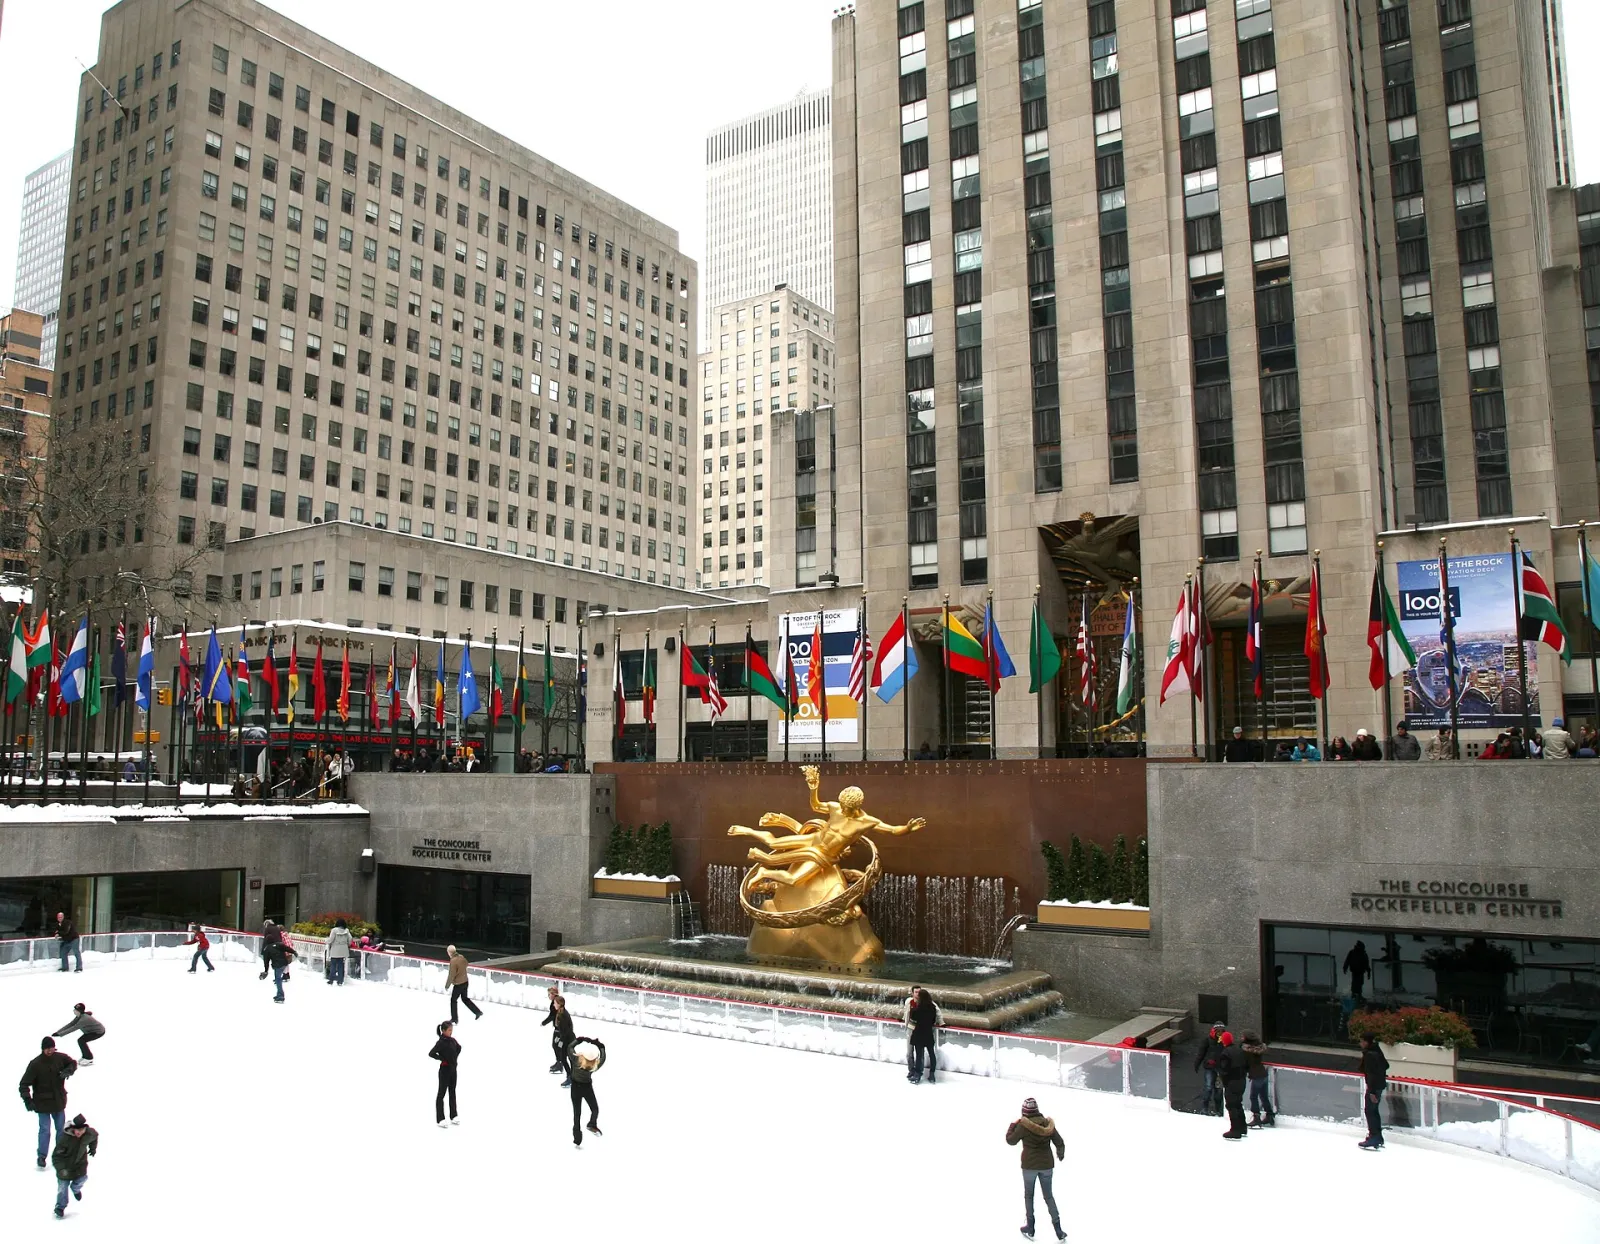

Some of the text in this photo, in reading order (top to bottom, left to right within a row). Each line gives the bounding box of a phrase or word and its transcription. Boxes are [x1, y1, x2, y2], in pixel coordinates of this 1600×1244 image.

[1420, 563, 1439, 571] TOP
[1454, 559, 1474, 568] THE
[1476, 558, 1503, 567] ROCK
[1428, 567, 1477, 577] OBVATION
[254, 634, 287, 646] NBC EWS
[320, 636, 365, 651] NBC NEWS
[423, 838, 480, 850] THE CONCOURSE
[412, 849, 492, 863] ROCKEFELLER CENTER
[1379, 879, 1530, 898] THE CONCOURSE
[1350, 897, 1563, 919] ROCKEFELLER CENTER
